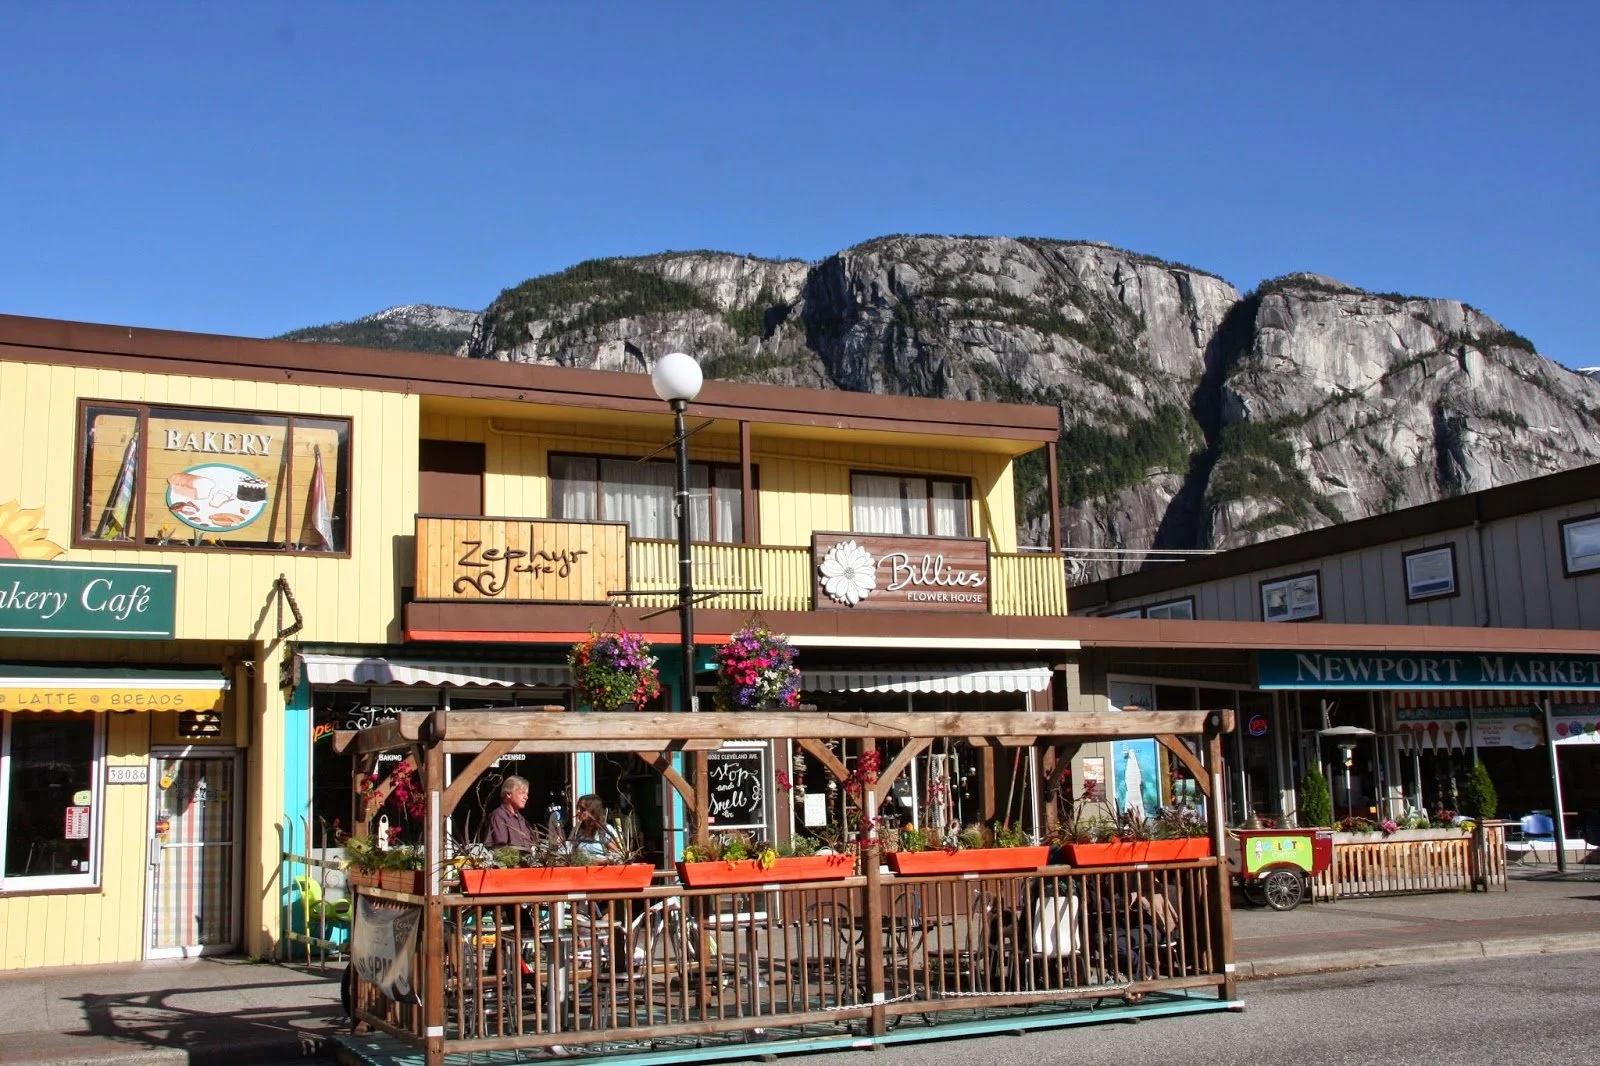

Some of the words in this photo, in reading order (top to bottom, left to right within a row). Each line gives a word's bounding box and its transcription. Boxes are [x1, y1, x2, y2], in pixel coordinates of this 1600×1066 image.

[164, 428, 273, 456] BAKERY
[453, 523, 589, 596] Zephyr
[513, 563, 554, 580] cafe
[877, 552, 986, 591] Billies
[82, 578, 152, 620] Café
[907, 592, 948, 602] FLOWER
[950, 593, 982, 603] HOUSE
[1295, 653, 1463, 683] NEWPORT
[1479, 656, 1600, 684] MARKET
[18, 693, 77, 705] LATTE
[111, 693, 184, 706] BREADS
[313, 718, 341, 744] pen
[378, 753, 402, 762] BAKING
[110, 769, 146, 780] 38086
